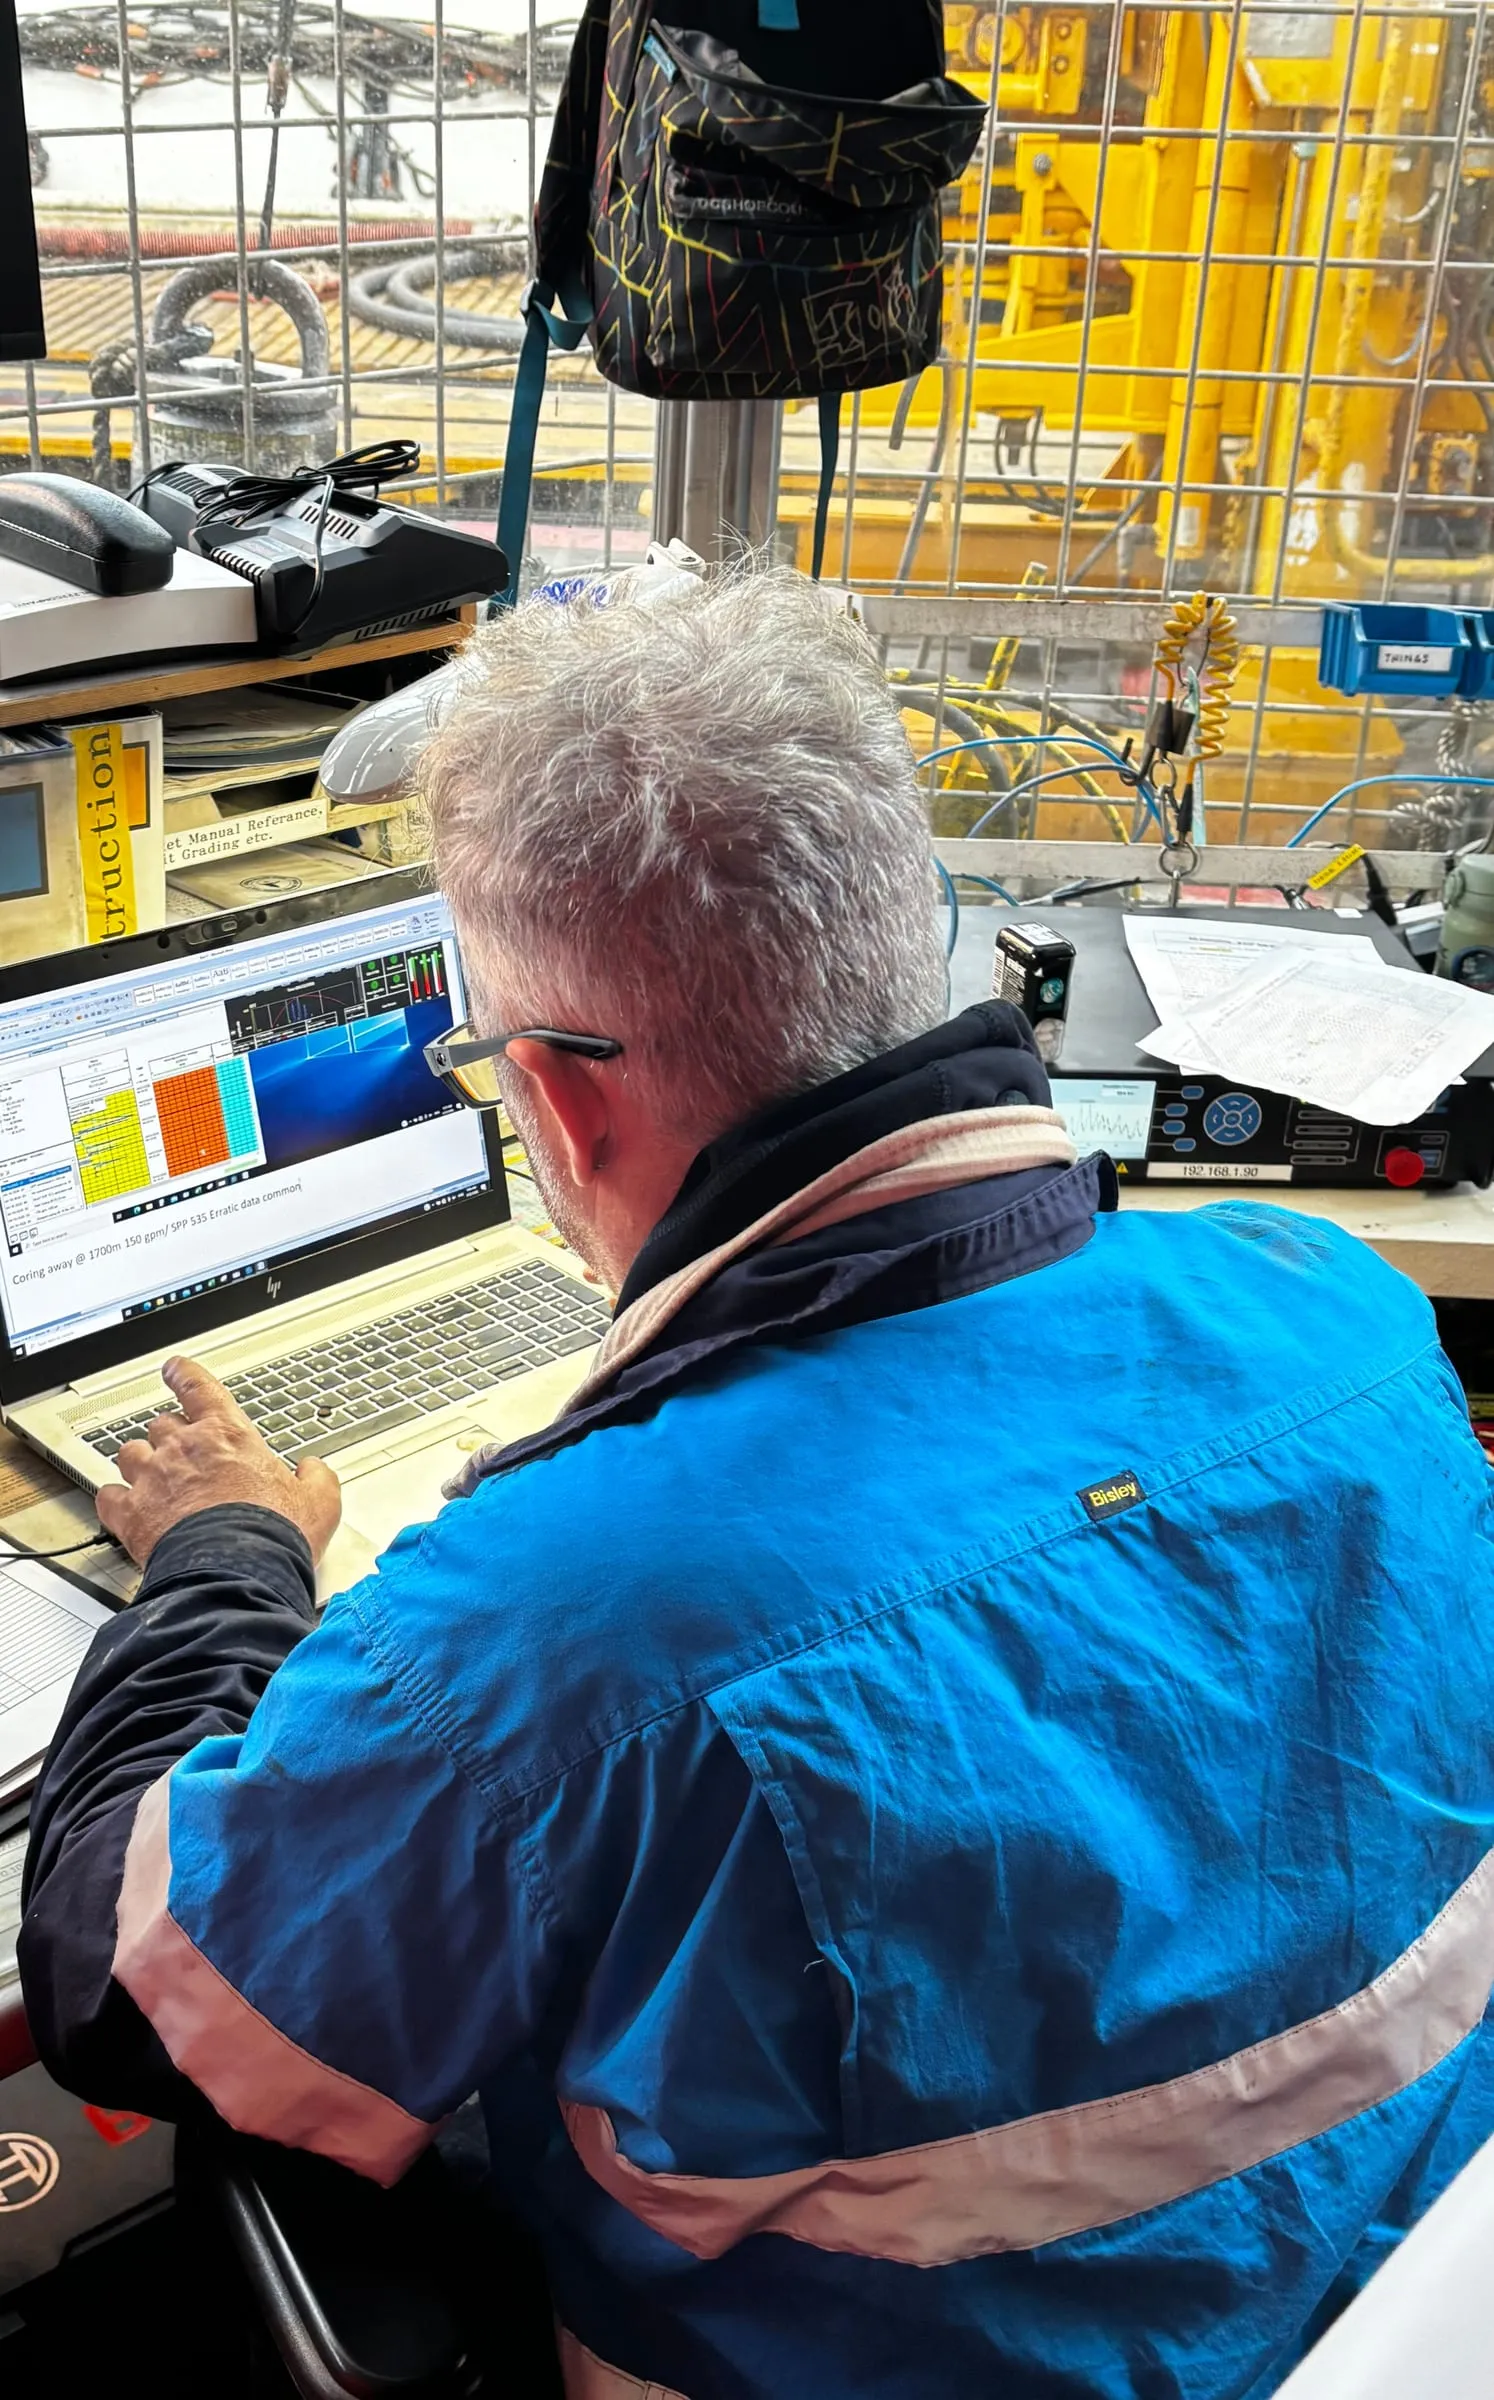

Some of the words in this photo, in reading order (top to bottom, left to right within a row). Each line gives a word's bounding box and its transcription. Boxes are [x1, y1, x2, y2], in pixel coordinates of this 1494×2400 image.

[1384, 653, 1429, 663] THINGS
[164, 839, 182, 851] et
[189, 823, 241, 845] Manual
[182, 840, 240, 861] Grading
[246, 831, 273, 845] etc.
[1183, 1166, 1258, 1177] 192.168.1.90
[12, 1268, 45, 1285] Coring
[48, 1259, 73, 1274] away
[76, 1253, 86, 1265] @
[89, 1243, 122, 1260] 1700m
[125, 1234, 142, 1248] 150
[144, 1223, 169, 1243] gpm/
[171, 1218, 188, 1233] SPP
[190, 1212, 208, 1227] 535
[209, 1203, 240, 1220] Erratic
[240, 1197, 261, 1210] data
[262, 1182, 301, 1203] common
[1089, 1482, 1136, 1507] Bisley
